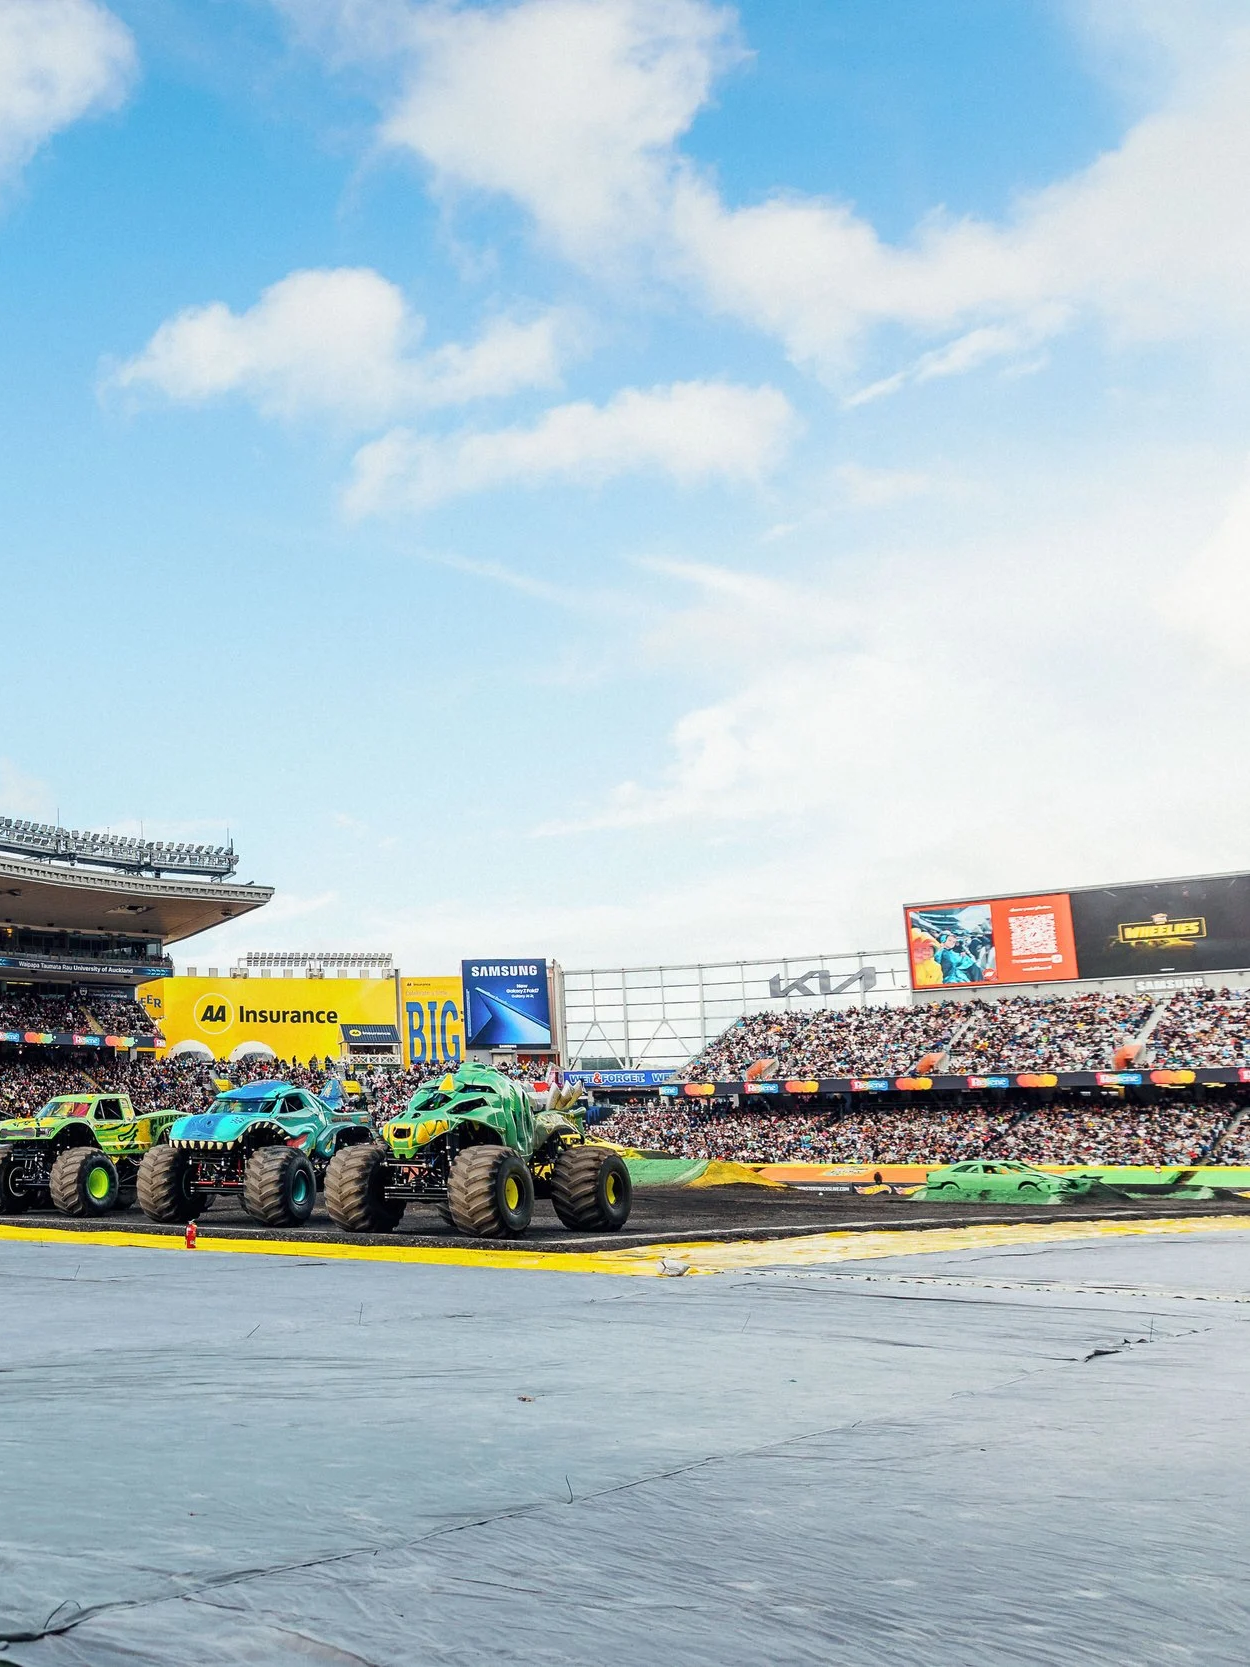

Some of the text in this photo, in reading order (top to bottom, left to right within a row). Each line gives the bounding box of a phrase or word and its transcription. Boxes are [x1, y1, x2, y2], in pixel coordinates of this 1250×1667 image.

[73, 965, 101, 973] University
[471, 965, 538, 977] SAMSUNG
[769, 966, 877, 998] KIA
[1136, 978, 1203, 991] SAMSUNG
[200, 1005, 338, 1023] AA Insurance
[406, 1000, 461, 1064] BIG
[75, 1035, 98, 1044] Resene
[971, 1077, 1007, 1087] Resene
[1100, 1073, 1139, 1083] Resene
[747, 1083, 776, 1092] Resene
[854, 1081, 886, 1091] Resene
